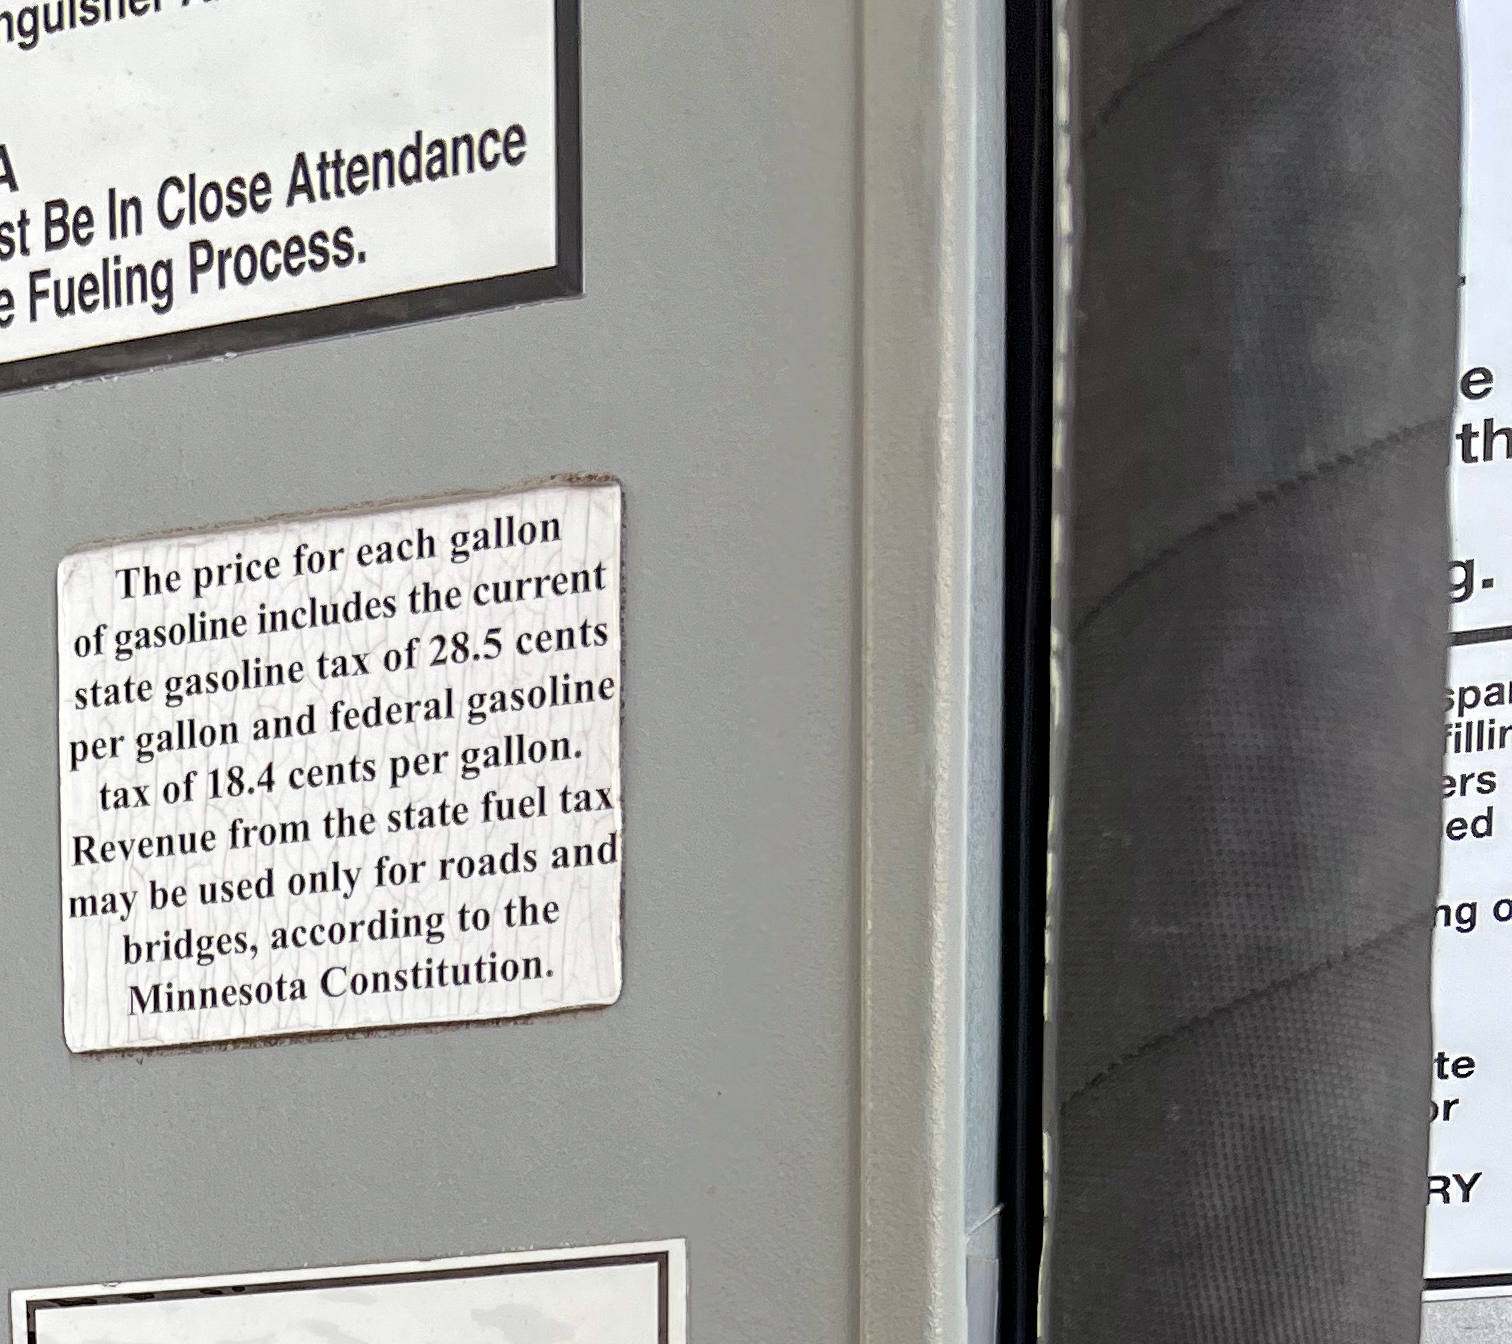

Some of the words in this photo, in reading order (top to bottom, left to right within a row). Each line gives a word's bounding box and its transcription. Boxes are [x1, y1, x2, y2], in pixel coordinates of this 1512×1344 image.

[45, 199, 93, 251] Be
[109, 188, 141, 239] In
[158, 172, 271, 229] Close
[287, 124, 525, 206] Attendance
[115, 566, 180, 598] The
[195, 553, 279, 598] price
[294, 544, 344, 575] for
[357, 528, 434, 566] each
[451, 516, 560, 563] gallon
[75, 624, 107, 657] of
[116, 612, 246, 661] gasoline
[259, 591, 396, 634] includes
[409, 582, 460, 613] the
[474, 562, 605, 605] current
[76, 677, 151, 709] state
[166, 658, 303, 707] gasoline
[318, 652, 369, 679] tax
[384, 638, 420, 671] of
[431, 628, 501, 666] 28.5
[517, 620, 607, 654] cents
[70, 736, 124, 771] per
[137, 719, 238, 763] gallon
[254, 705, 315, 740] and
[332, 688, 452, 731] federal
[468, 674, 614, 724] gasoline
[74, 831, 215, 865] Revenue
[229, 819, 309, 848] from
[324, 808, 375, 838] the
[389, 799, 468, 832] state
[482, 786, 545, 822] fuel
[560, 786, 612, 813] tax
[124, 929, 257, 965] bridges,
[272, 908, 444, 949] according
[459, 904, 489, 931] to
[505, 896, 558, 927] the
[130, 975, 306, 1015] Minnesota
[321, 952, 552, 997] Constitution.
